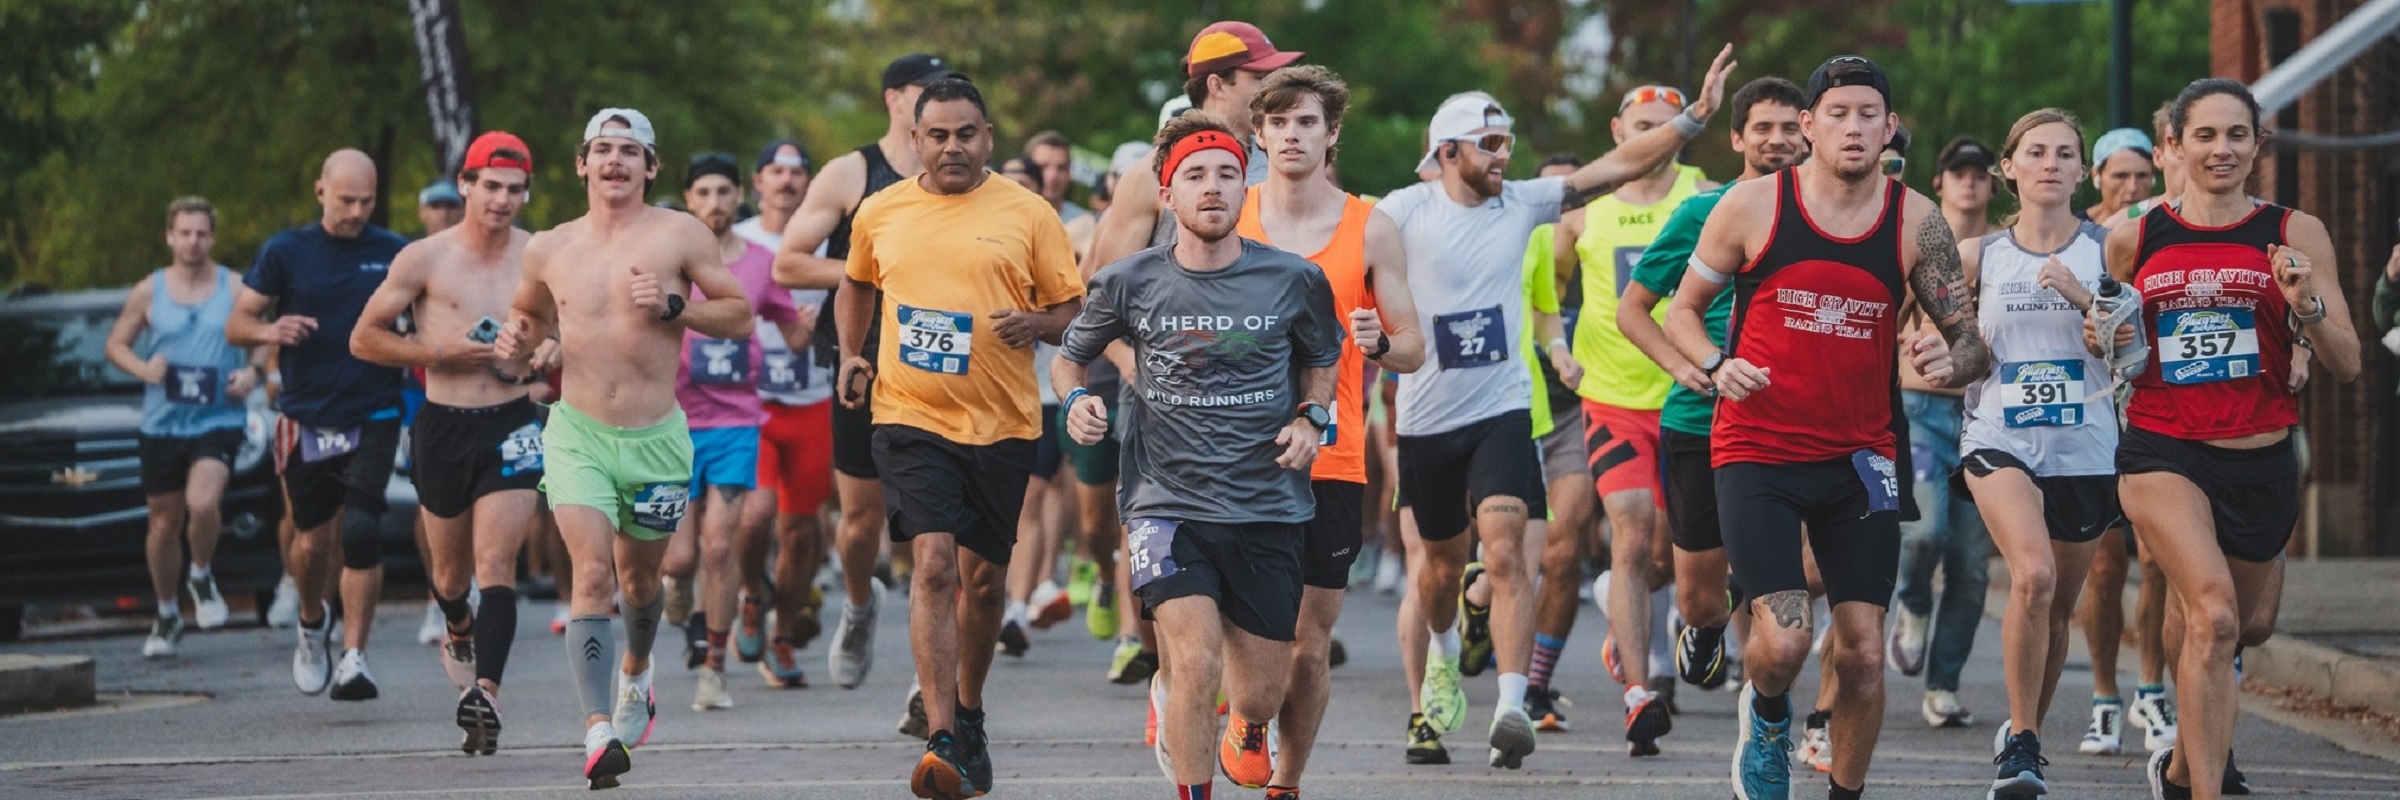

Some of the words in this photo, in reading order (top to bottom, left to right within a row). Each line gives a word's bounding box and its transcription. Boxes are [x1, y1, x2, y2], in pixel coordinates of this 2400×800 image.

[1618, 212, 1655, 226] PACE
[2143, 270, 2186, 293] HIGH
[2188, 268, 2271, 288] GRAVITY
[1777, 288, 1819, 308] HIGH
[1820, 294, 1888, 318] GRAVITY
[2006, 303, 2049, 312] RACING
[2157, 296, 2212, 312] RACING
[2215, 296, 2259, 311] TEAM
[1138, 317, 1151, 331] A
[1161, 315, 1234, 331] HERD
[1243, 315, 1279, 330] OF
[1784, 316, 1833, 334] RACING
[1835, 325, 1873, 339] TEAM
[910, 328, 954, 352] 376
[1459, 337, 1485, 355] 27
[2179, 331, 2236, 359] 357
[1147, 388, 1182, 405] WILD
[1189, 389, 1275, 406] RUNNERS
[2022, 383, 2067, 404] 391
[650, 499, 687, 518] 344
